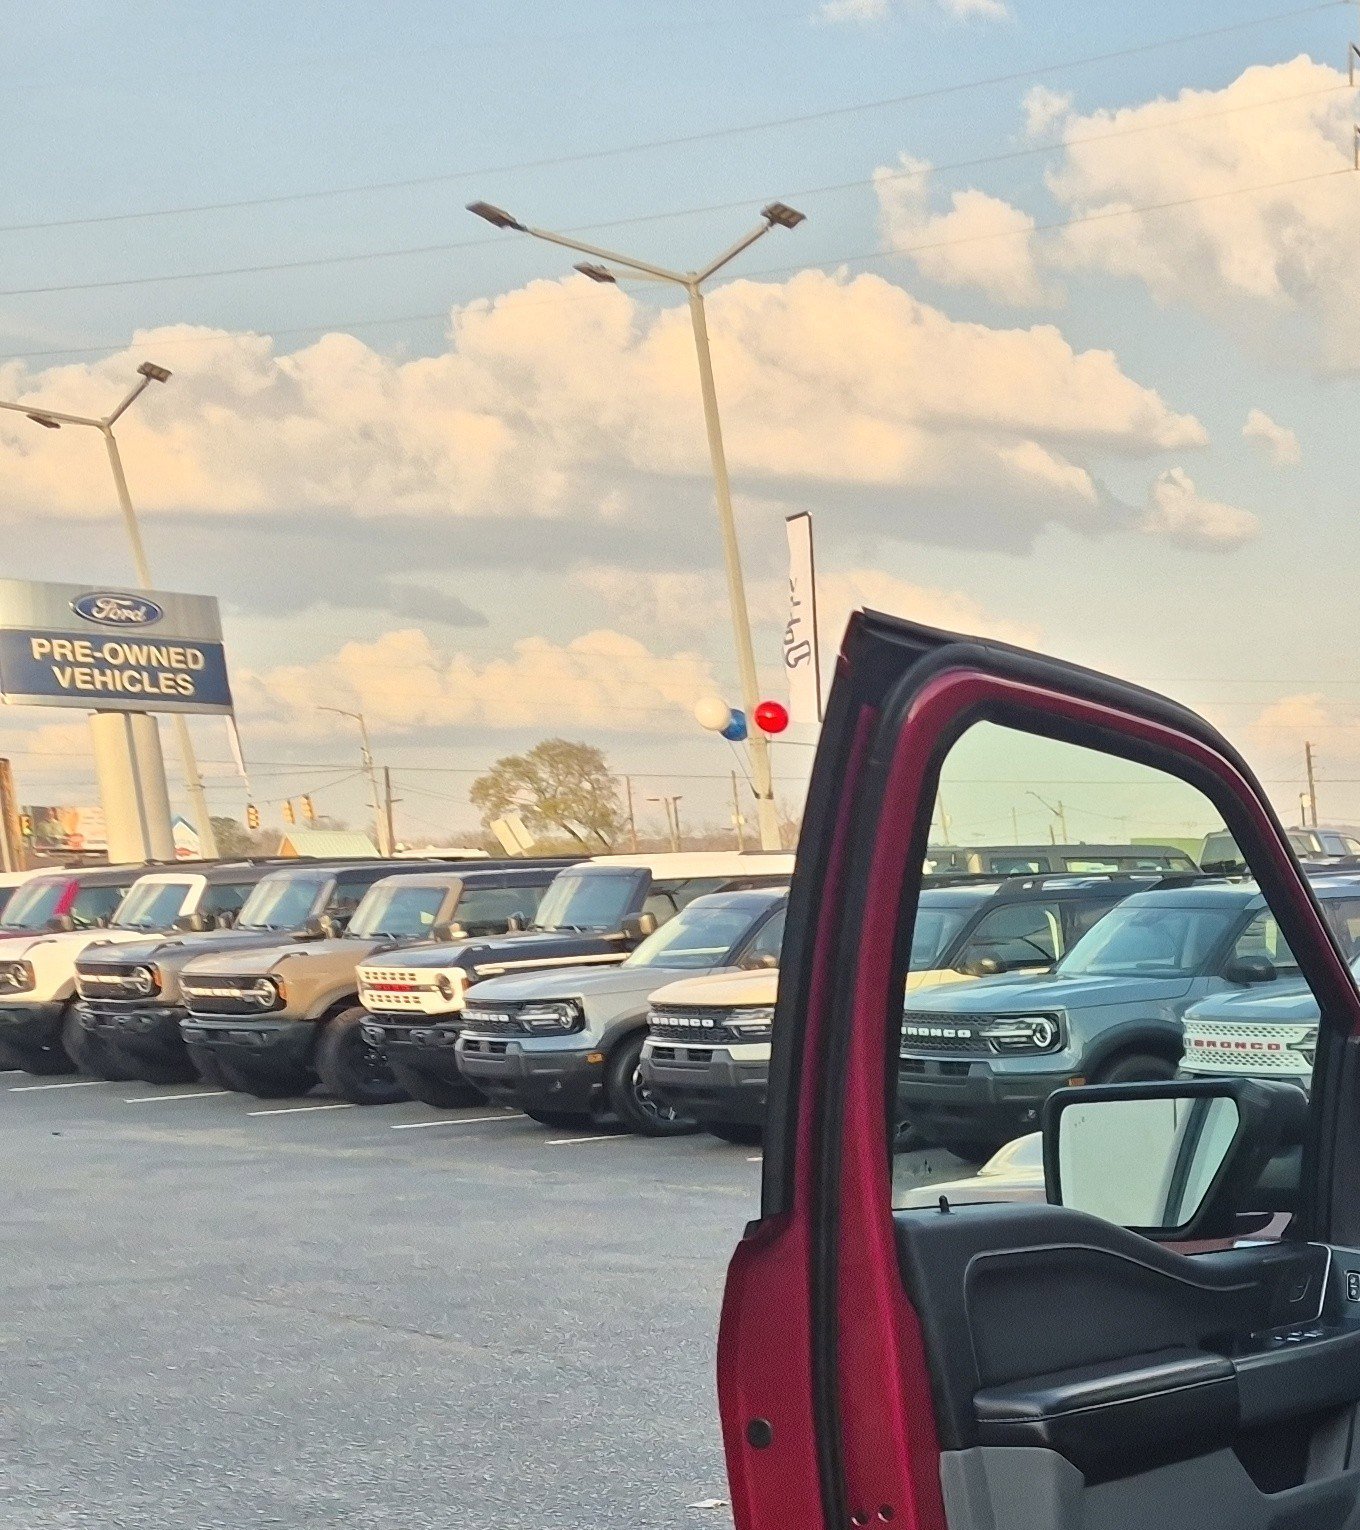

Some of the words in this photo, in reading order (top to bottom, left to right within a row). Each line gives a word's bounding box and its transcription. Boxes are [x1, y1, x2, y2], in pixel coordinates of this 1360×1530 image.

[90, 597, 148, 622] Ford
[30, 637, 205, 671] PRE-OWNED
[52, 665, 196, 696] VEHICLES
[1194, 1039, 1281, 1051] BRONCO
